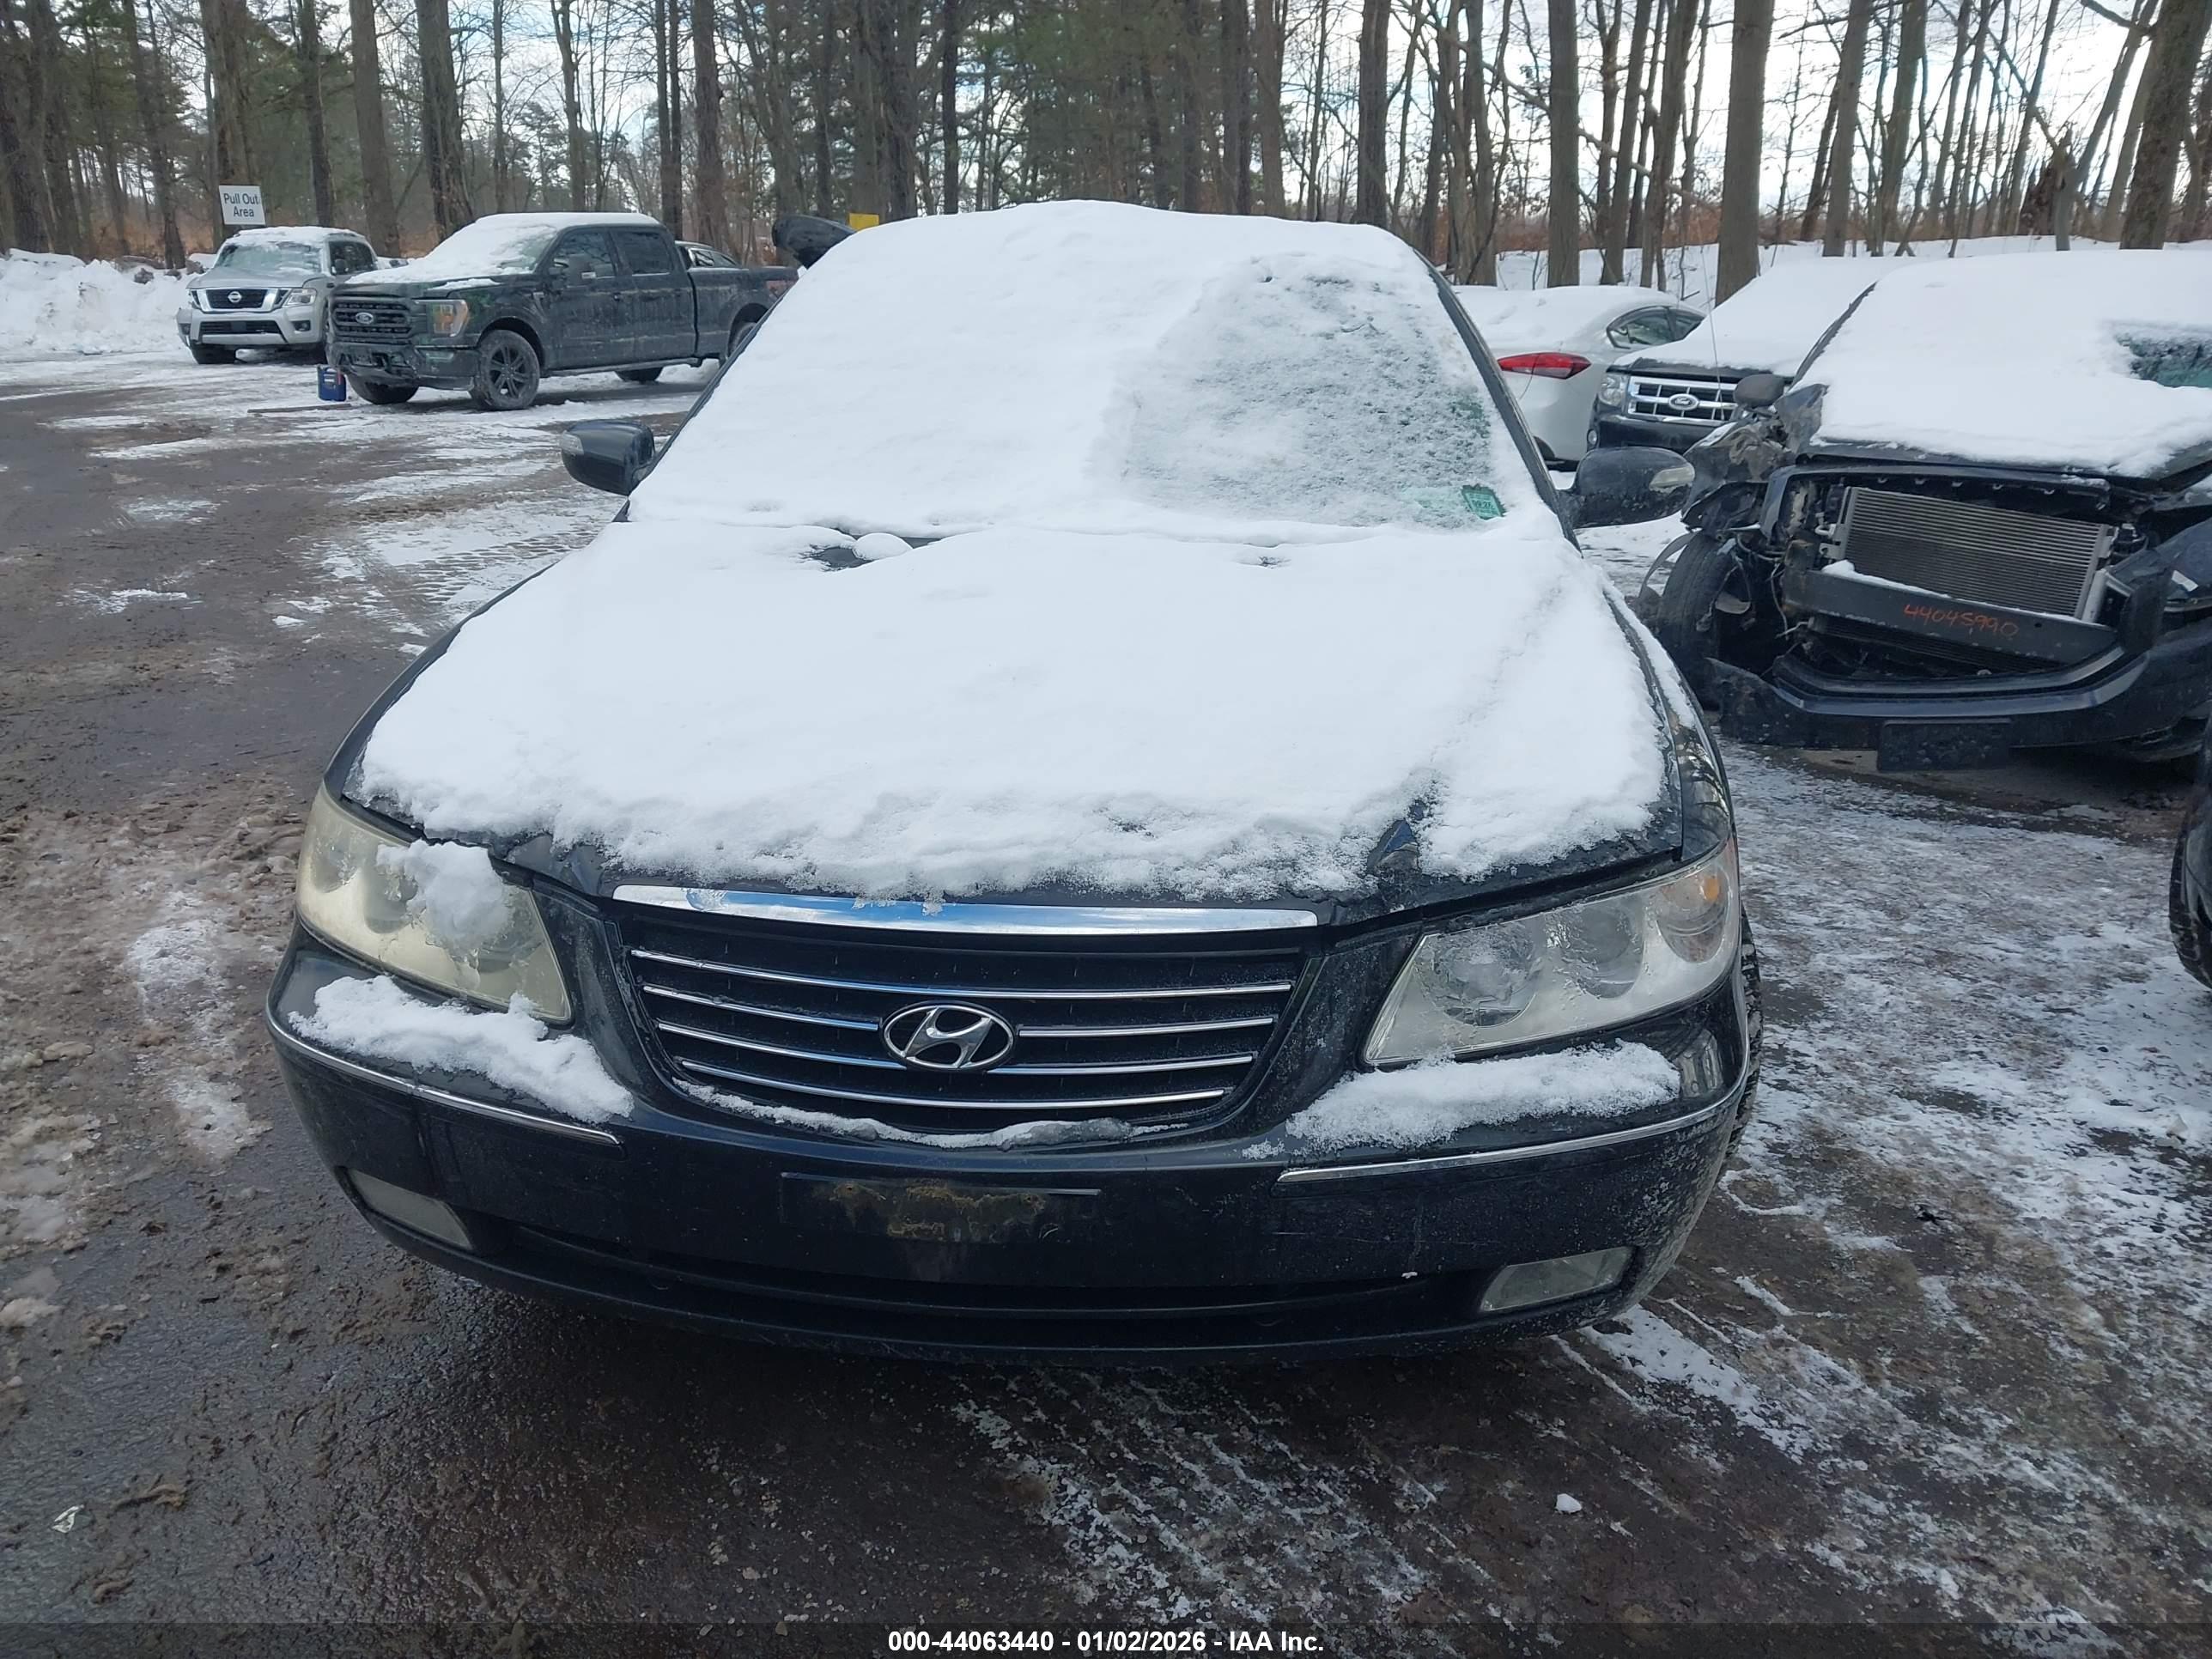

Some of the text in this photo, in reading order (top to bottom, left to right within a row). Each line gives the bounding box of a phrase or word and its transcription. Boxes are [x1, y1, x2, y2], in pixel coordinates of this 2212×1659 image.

[223, 192, 259, 205] Pull Out
[233, 205, 255, 217] Area
[1903, 604, 2019, 637] 44045990
